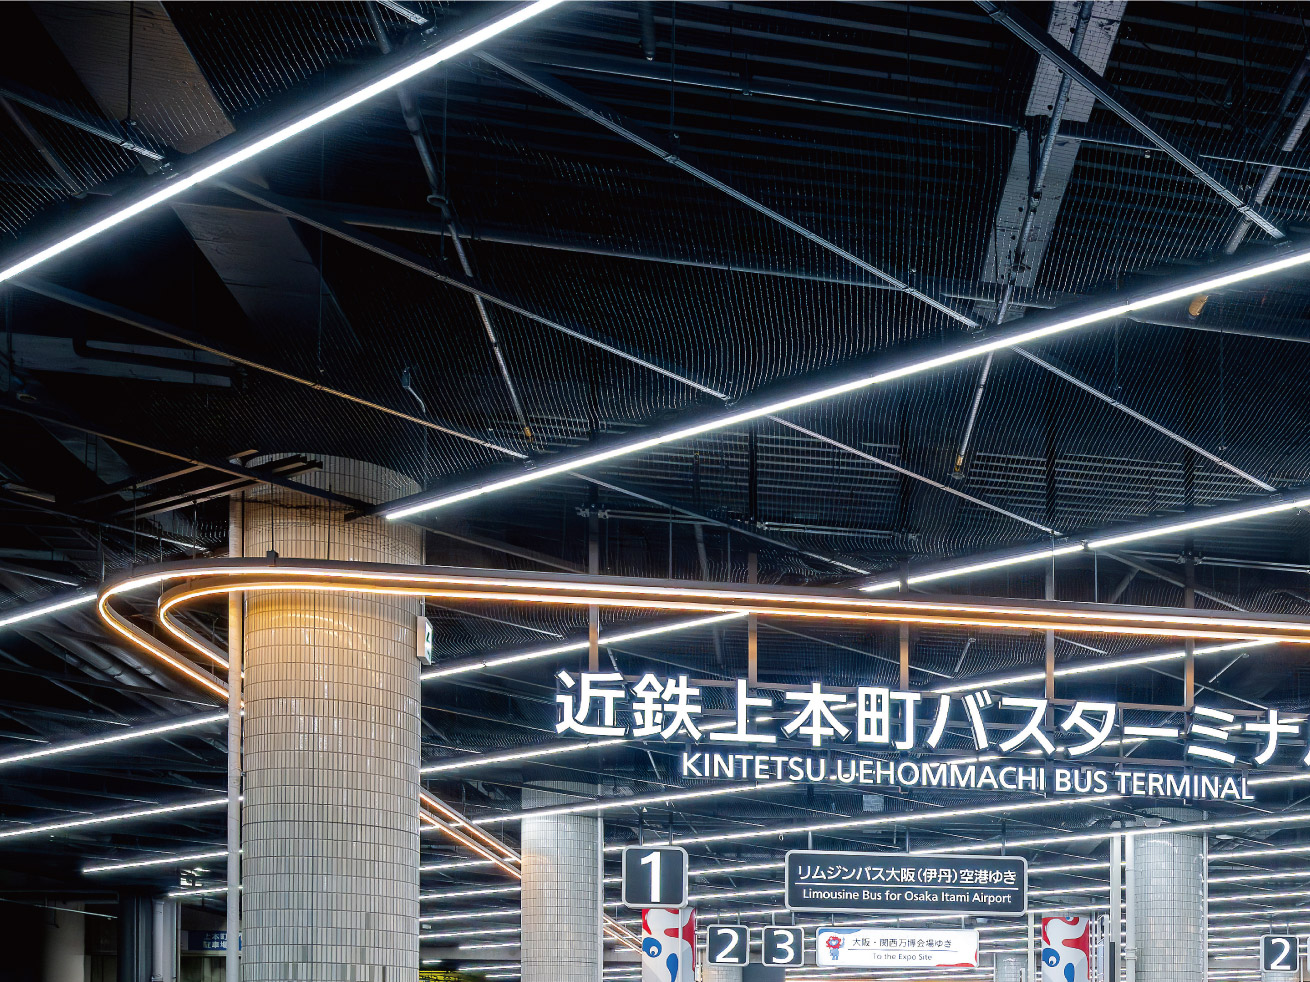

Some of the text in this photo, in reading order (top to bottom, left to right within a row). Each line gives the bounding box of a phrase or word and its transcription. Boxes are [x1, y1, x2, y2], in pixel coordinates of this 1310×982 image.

[682, 752, 1255, 800] KINTETSU UEHOMMACHI BUS TERMINAL
[640, 851, 661, 903] 1
[803, 889, 1012, 905] Limousine Bus for Osaka Itami Airport
[715, 928, 739, 963] 2
[772, 929, 795, 964] 3
[898, 953, 917, 962] Expo
[918, 953, 933, 961] Site
[1270, 937, 1291, 970] 2
